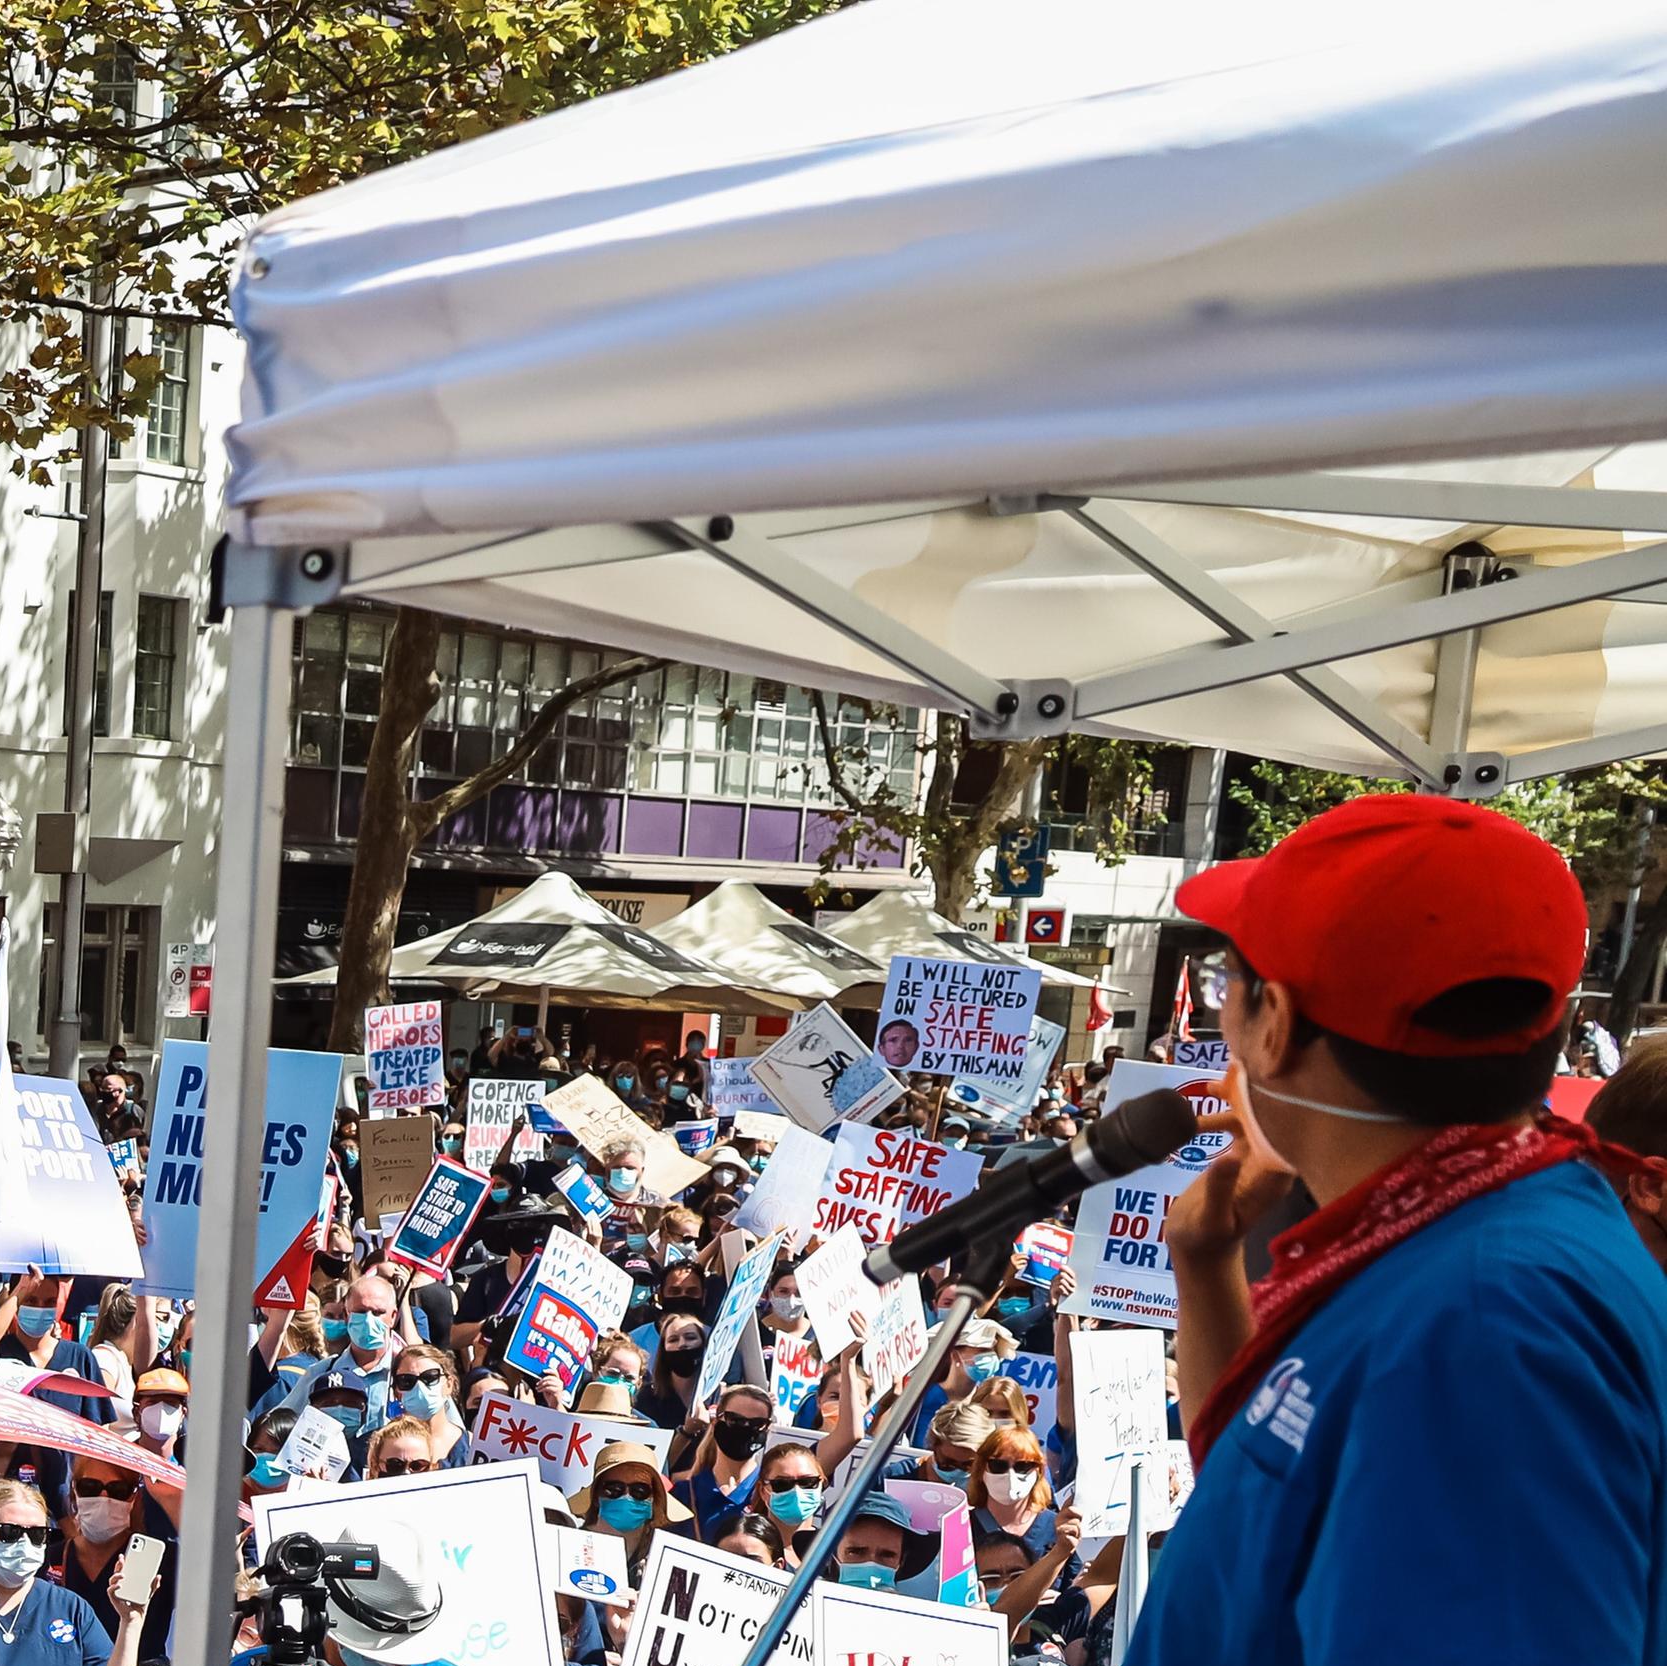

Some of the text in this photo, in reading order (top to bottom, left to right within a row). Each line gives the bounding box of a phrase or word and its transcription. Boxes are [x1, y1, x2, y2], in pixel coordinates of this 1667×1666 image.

[921, 963, 1021, 989] WILL NOT
[933, 983, 1028, 1009] LECTURED
[368, 1004, 437, 1028] CALLED
[924, 1001, 996, 1027] SAFE
[369, 1025, 441, 1051] HEROES
[923, 1026, 1025, 1056] STAFFING
[370, 1048, 441, 1071] TREATED
[950, 1053, 1022, 1078] THIS MAN
[381, 1067, 428, 1089] LIKE
[472, 1082, 536, 1100] COPING
[373, 1082, 442, 1107] ZEROES
[868, 1132, 948, 1179] SAFE
[813, 1199, 893, 1243] SAVES
[1103, 1238, 1158, 1268] FOR
